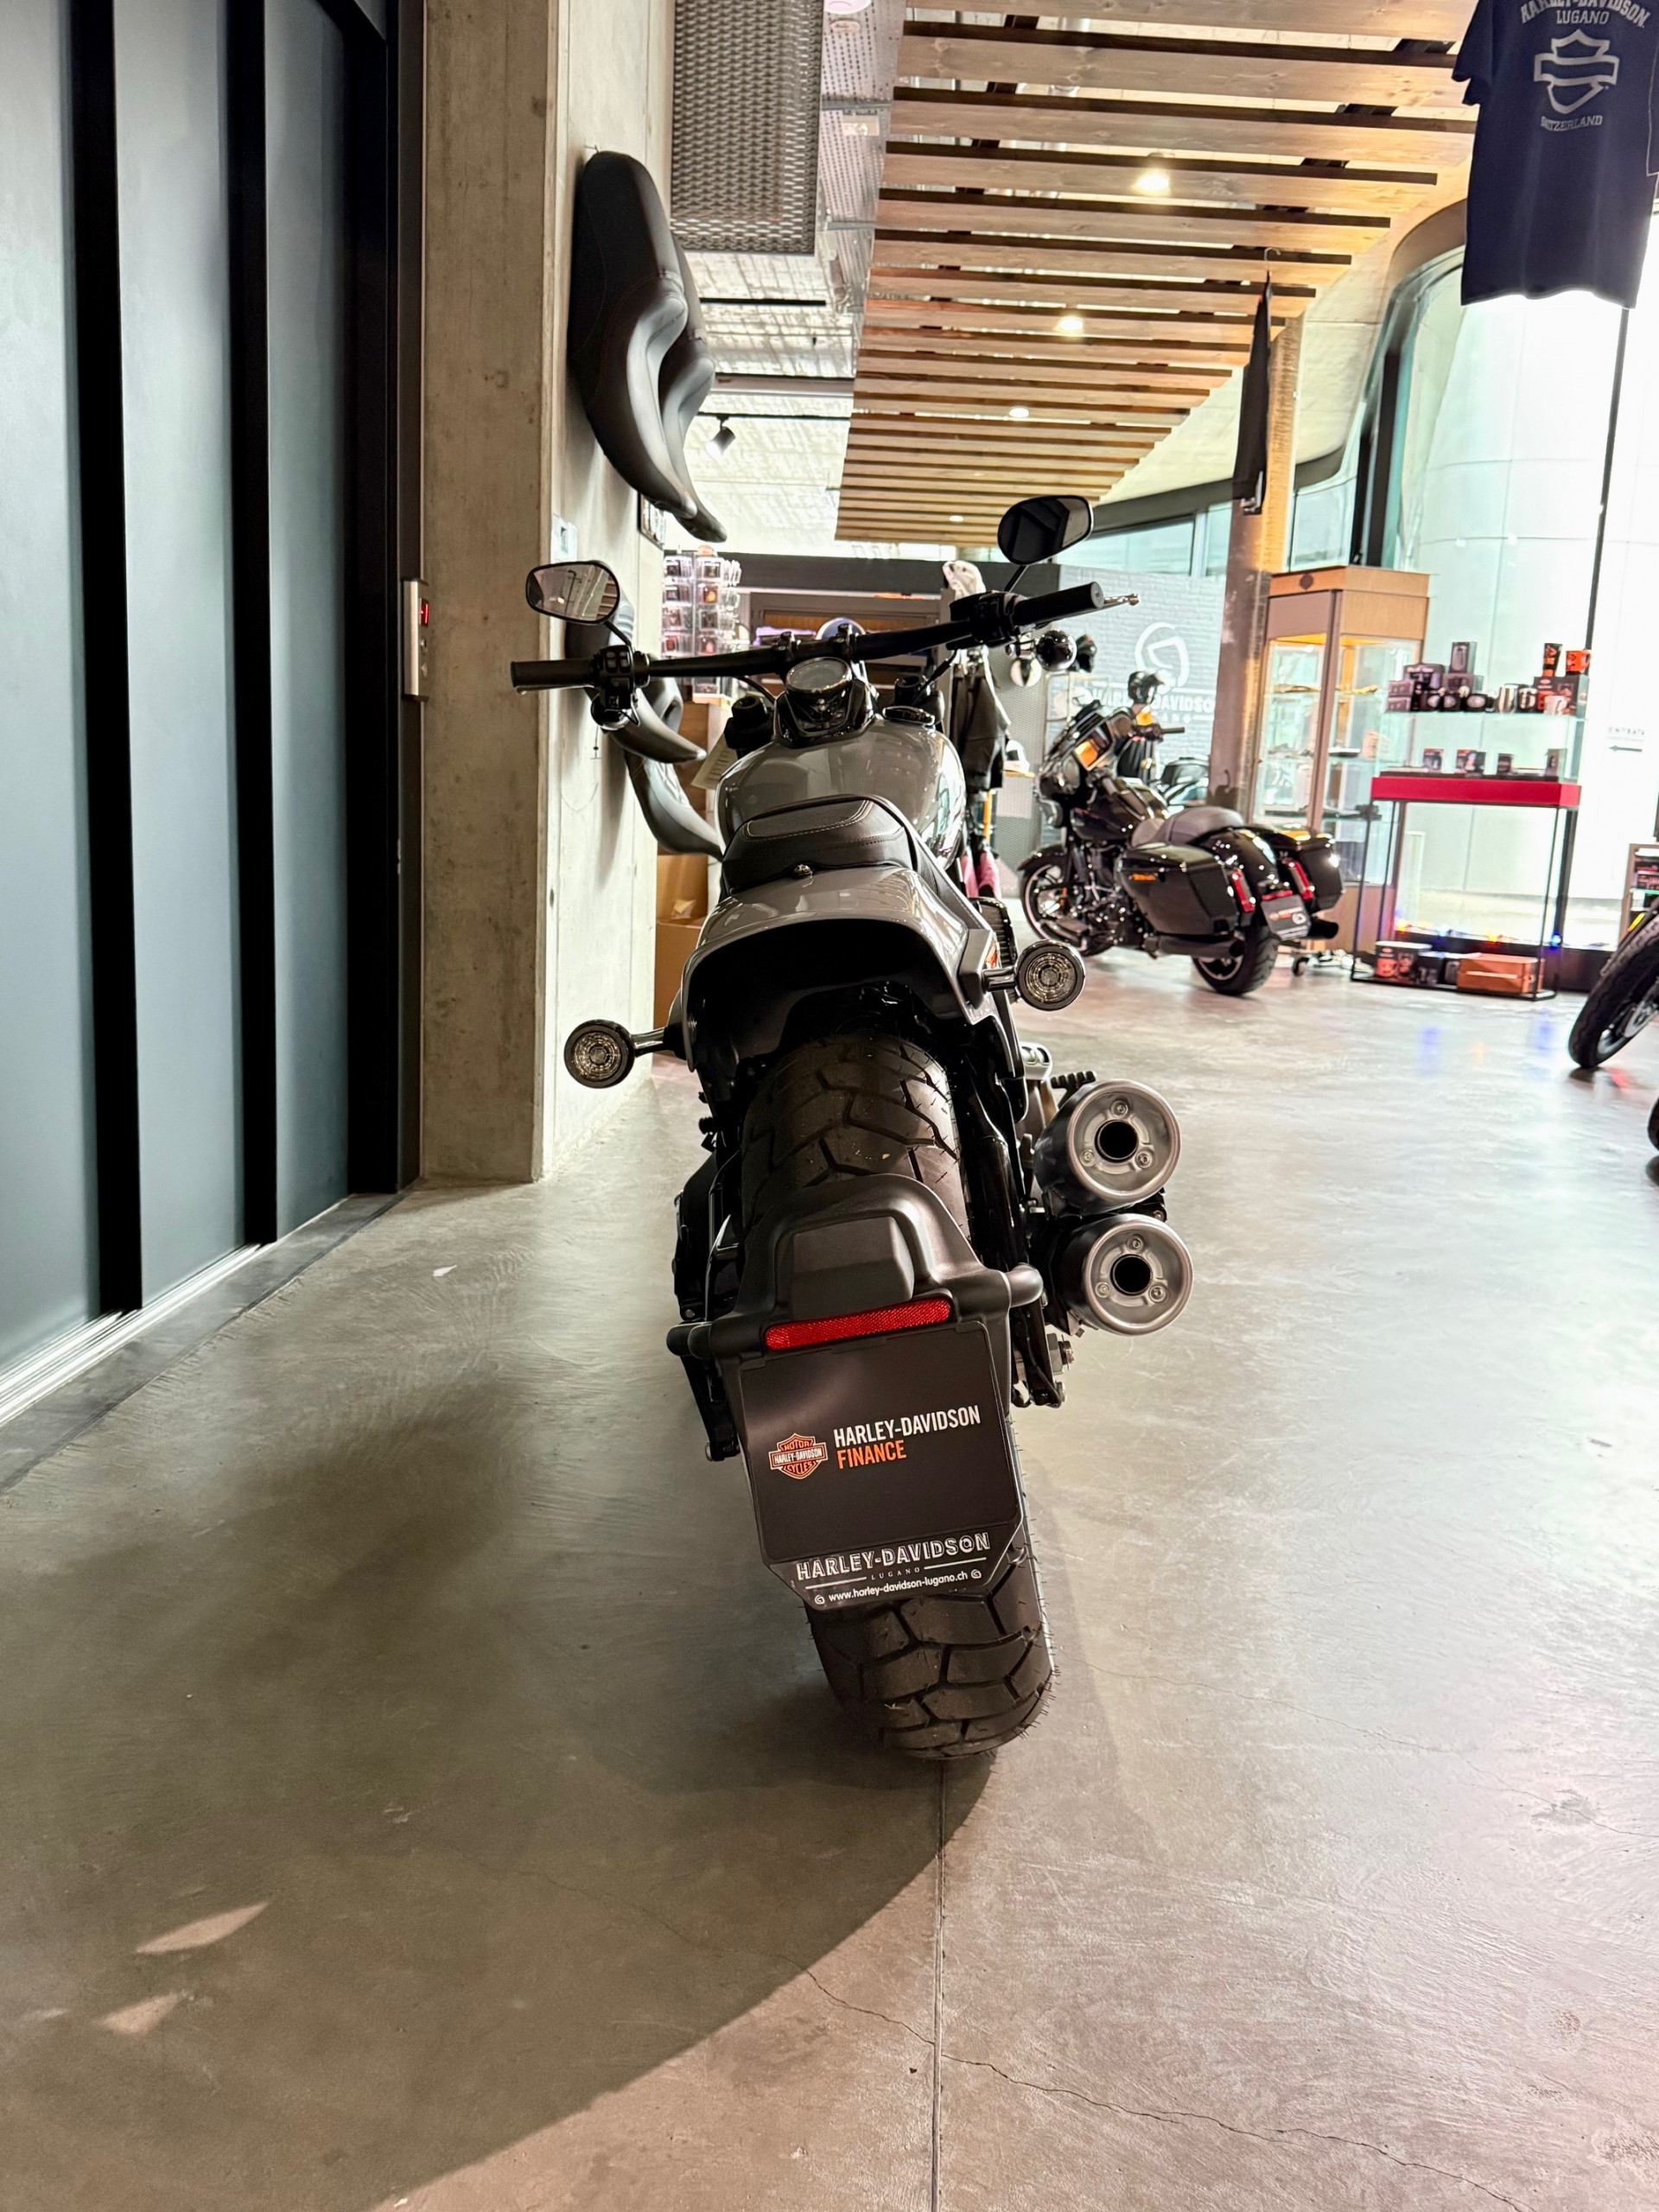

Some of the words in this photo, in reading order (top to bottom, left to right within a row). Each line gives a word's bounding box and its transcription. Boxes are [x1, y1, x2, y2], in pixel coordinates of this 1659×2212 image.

[1556, 10, 1610, 24] LUGANO
[834, 1405, 981, 1447] HARLEY-DAVIDSON
[784, 1440, 810, 1451] MOTOR
[774, 1447, 823, 1465] HARLEY-DAVIDSON
[837, 1440, 906, 1470] FINANCE
[787, 1461, 813, 1474] CYCLES
[797, 1532, 991, 1580] HARLEY-DAVIDSON
[871, 1566, 920, 1580] LUGANO
[829, 1571, 969, 1602] www.harley-davidson-lugano.ch
